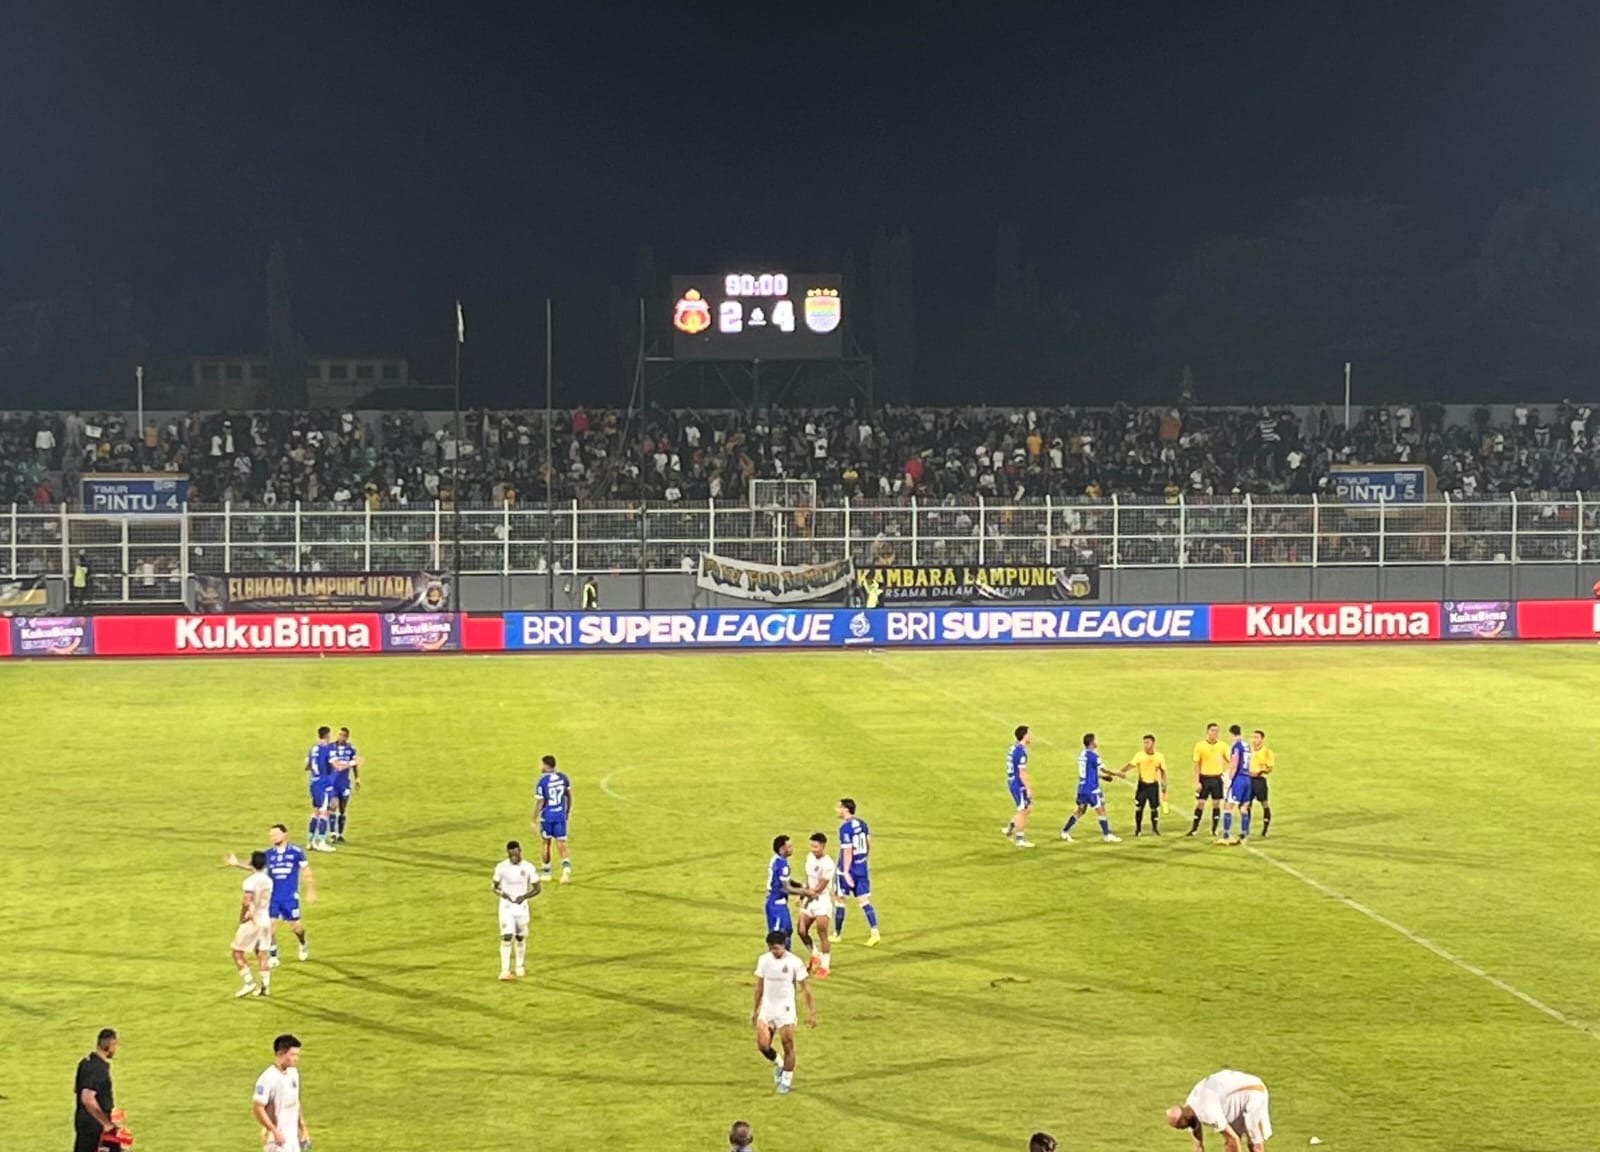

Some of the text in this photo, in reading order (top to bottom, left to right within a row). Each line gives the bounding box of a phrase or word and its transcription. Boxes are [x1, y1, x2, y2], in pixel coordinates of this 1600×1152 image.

[725, 273, 788, 296] 90:00
[719, 300, 795, 333] 2 4
[93, 485, 128, 494] TIMUR
[1336, 485, 1396, 500] PINTU
[93, 494, 179, 511] PINTU 4
[297, 576, 366, 597] LAMPUNG
[367, 576, 414, 600] UTARA
[963, 566, 1057, 587] LAMPUNG
[932, 585, 974, 597] DALAM
[176, 617, 370, 648] KukuBima
[523, 613, 834, 645] BRI SUPER LEAGUE
[887, 609, 1194, 641] BRI SUPER LEAGUE
[1246, 605, 1430, 637] KukuBima
